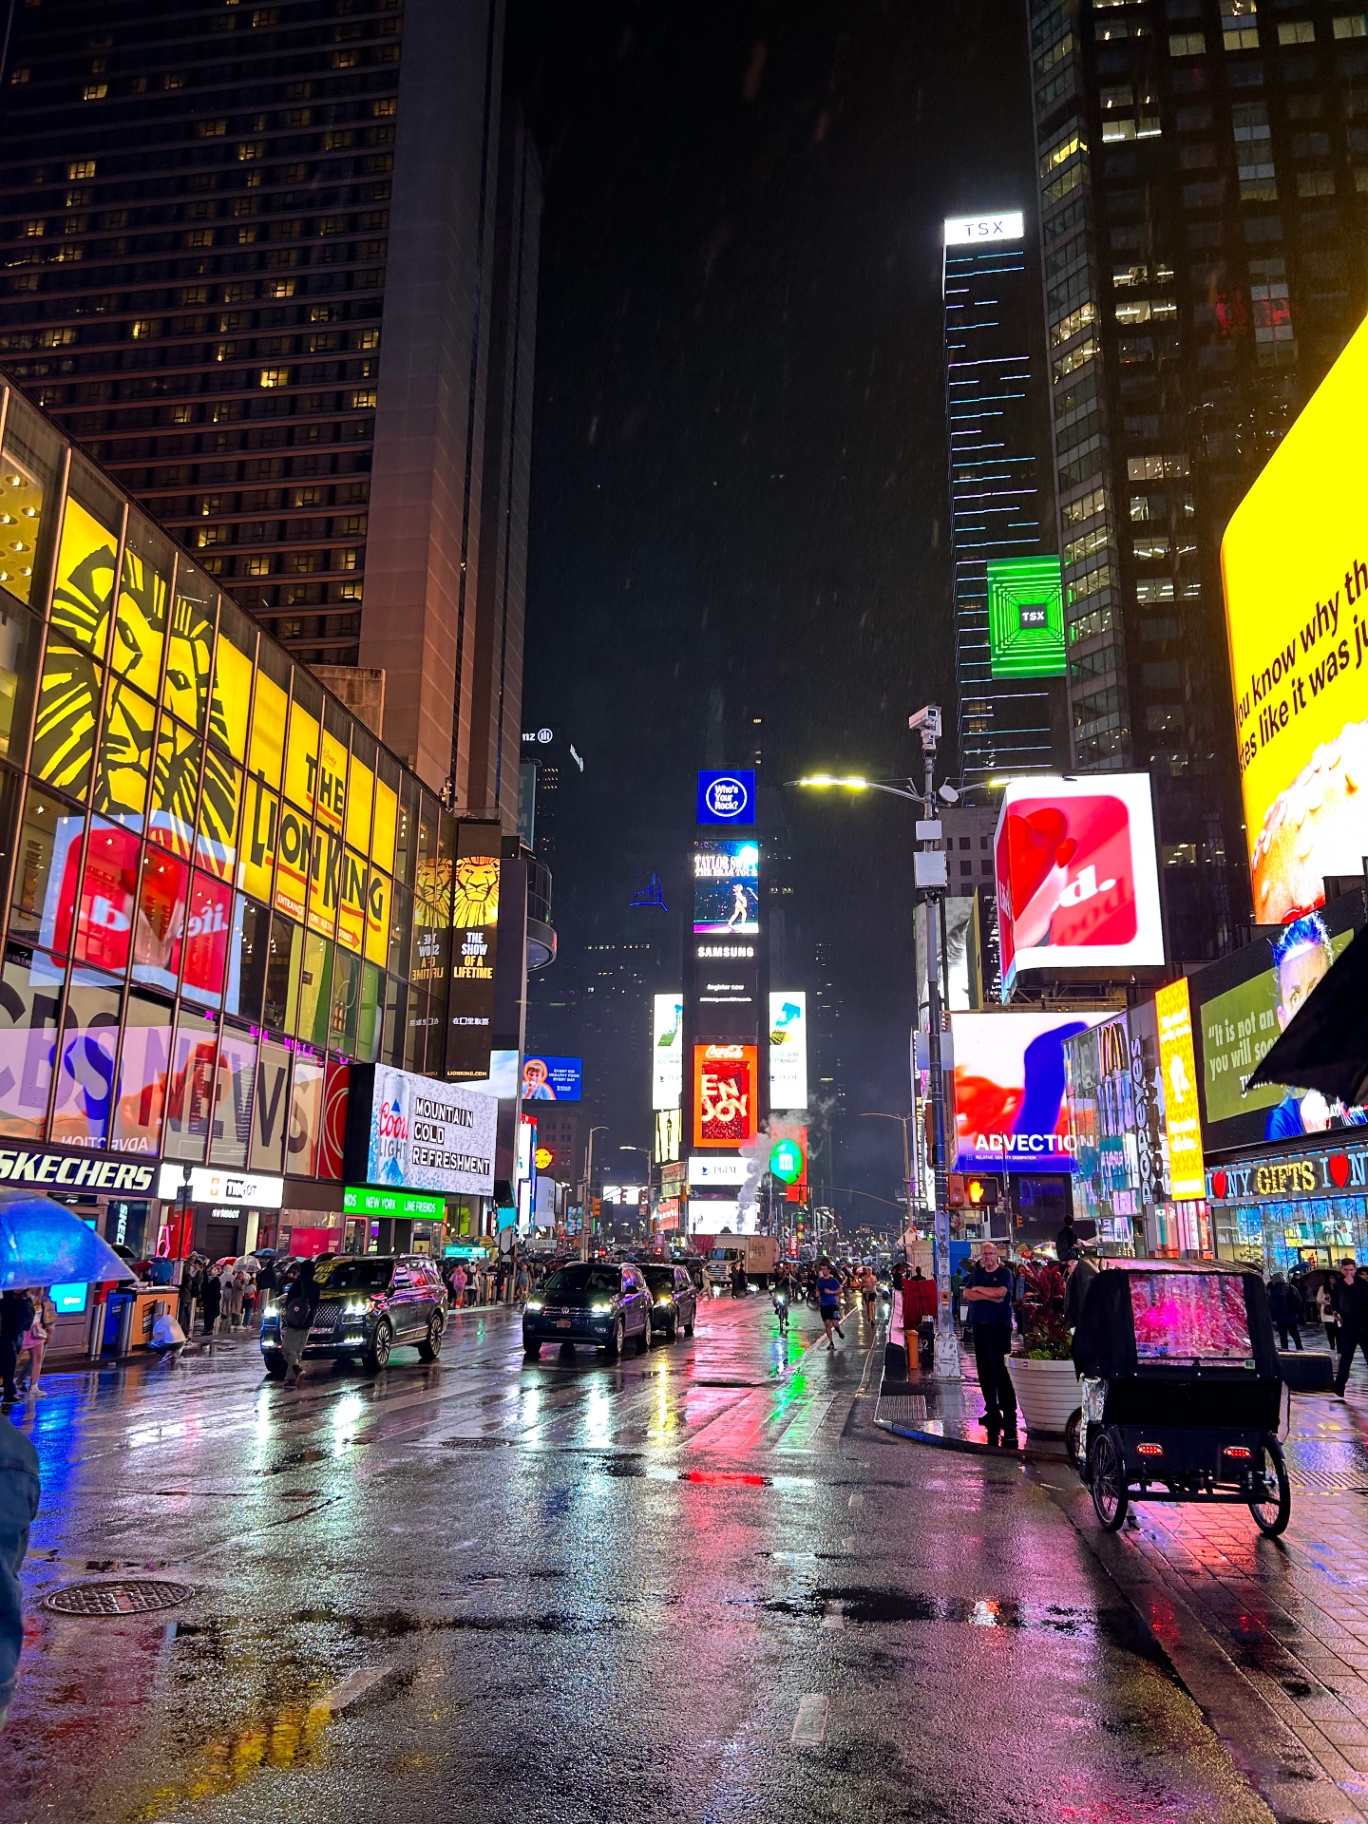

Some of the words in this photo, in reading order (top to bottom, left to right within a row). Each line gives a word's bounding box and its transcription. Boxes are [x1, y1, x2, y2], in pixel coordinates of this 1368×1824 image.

[964, 221, 1003, 236] TSX
[1021, 611, 1045, 621] TSX
[1252, 638, 1296, 707] know
[1300, 590, 1340, 654] why
[1259, 699, 1289, 747] like
[1292, 676, 1306, 715] it
[1309, 638, 1350, 698] was
[306, 752, 345, 817] THE
[714, 785, 738, 794] Who's
[714, 793, 733, 802] Your
[715, 801, 738, 810] Rock?
[250, 769, 323, 881] LION
[323, 824, 383, 922] KING
[277, 894, 304, 914] ENTRANCE
[466, 932, 484, 943] THE
[461, 944, 488, 956] SHOW
[698, 946, 754, 957] SAMSUNG
[464, 956, 476, 967] OF
[477, 957, 484, 967] A
[454, 967, 493, 979] LIFETIME
[1225, 1019, 1235, 1042] is
[1237, 1011, 1256, 1038] not
[1259, 1009, 1274, 1030] an
[1209, 1055, 1229, 1081] you
[1231, 1038, 1251, 1068] will
[415, 1097, 473, 1128] MOUNTAIN
[414, 1122, 445, 1145] COLD
[412, 1146, 490, 1175] REFRESHMENT
[0, 1150, 155, 1191] SKECHERS
[1257, 1161, 1316, 1195] GIFTS
[227, 1180, 257, 1197] TISSOT
[366, 1197, 379, 1208] NEW
[382, 1198, 397, 1210] YORK
[416, 1201, 436, 1214] FRIENDS
